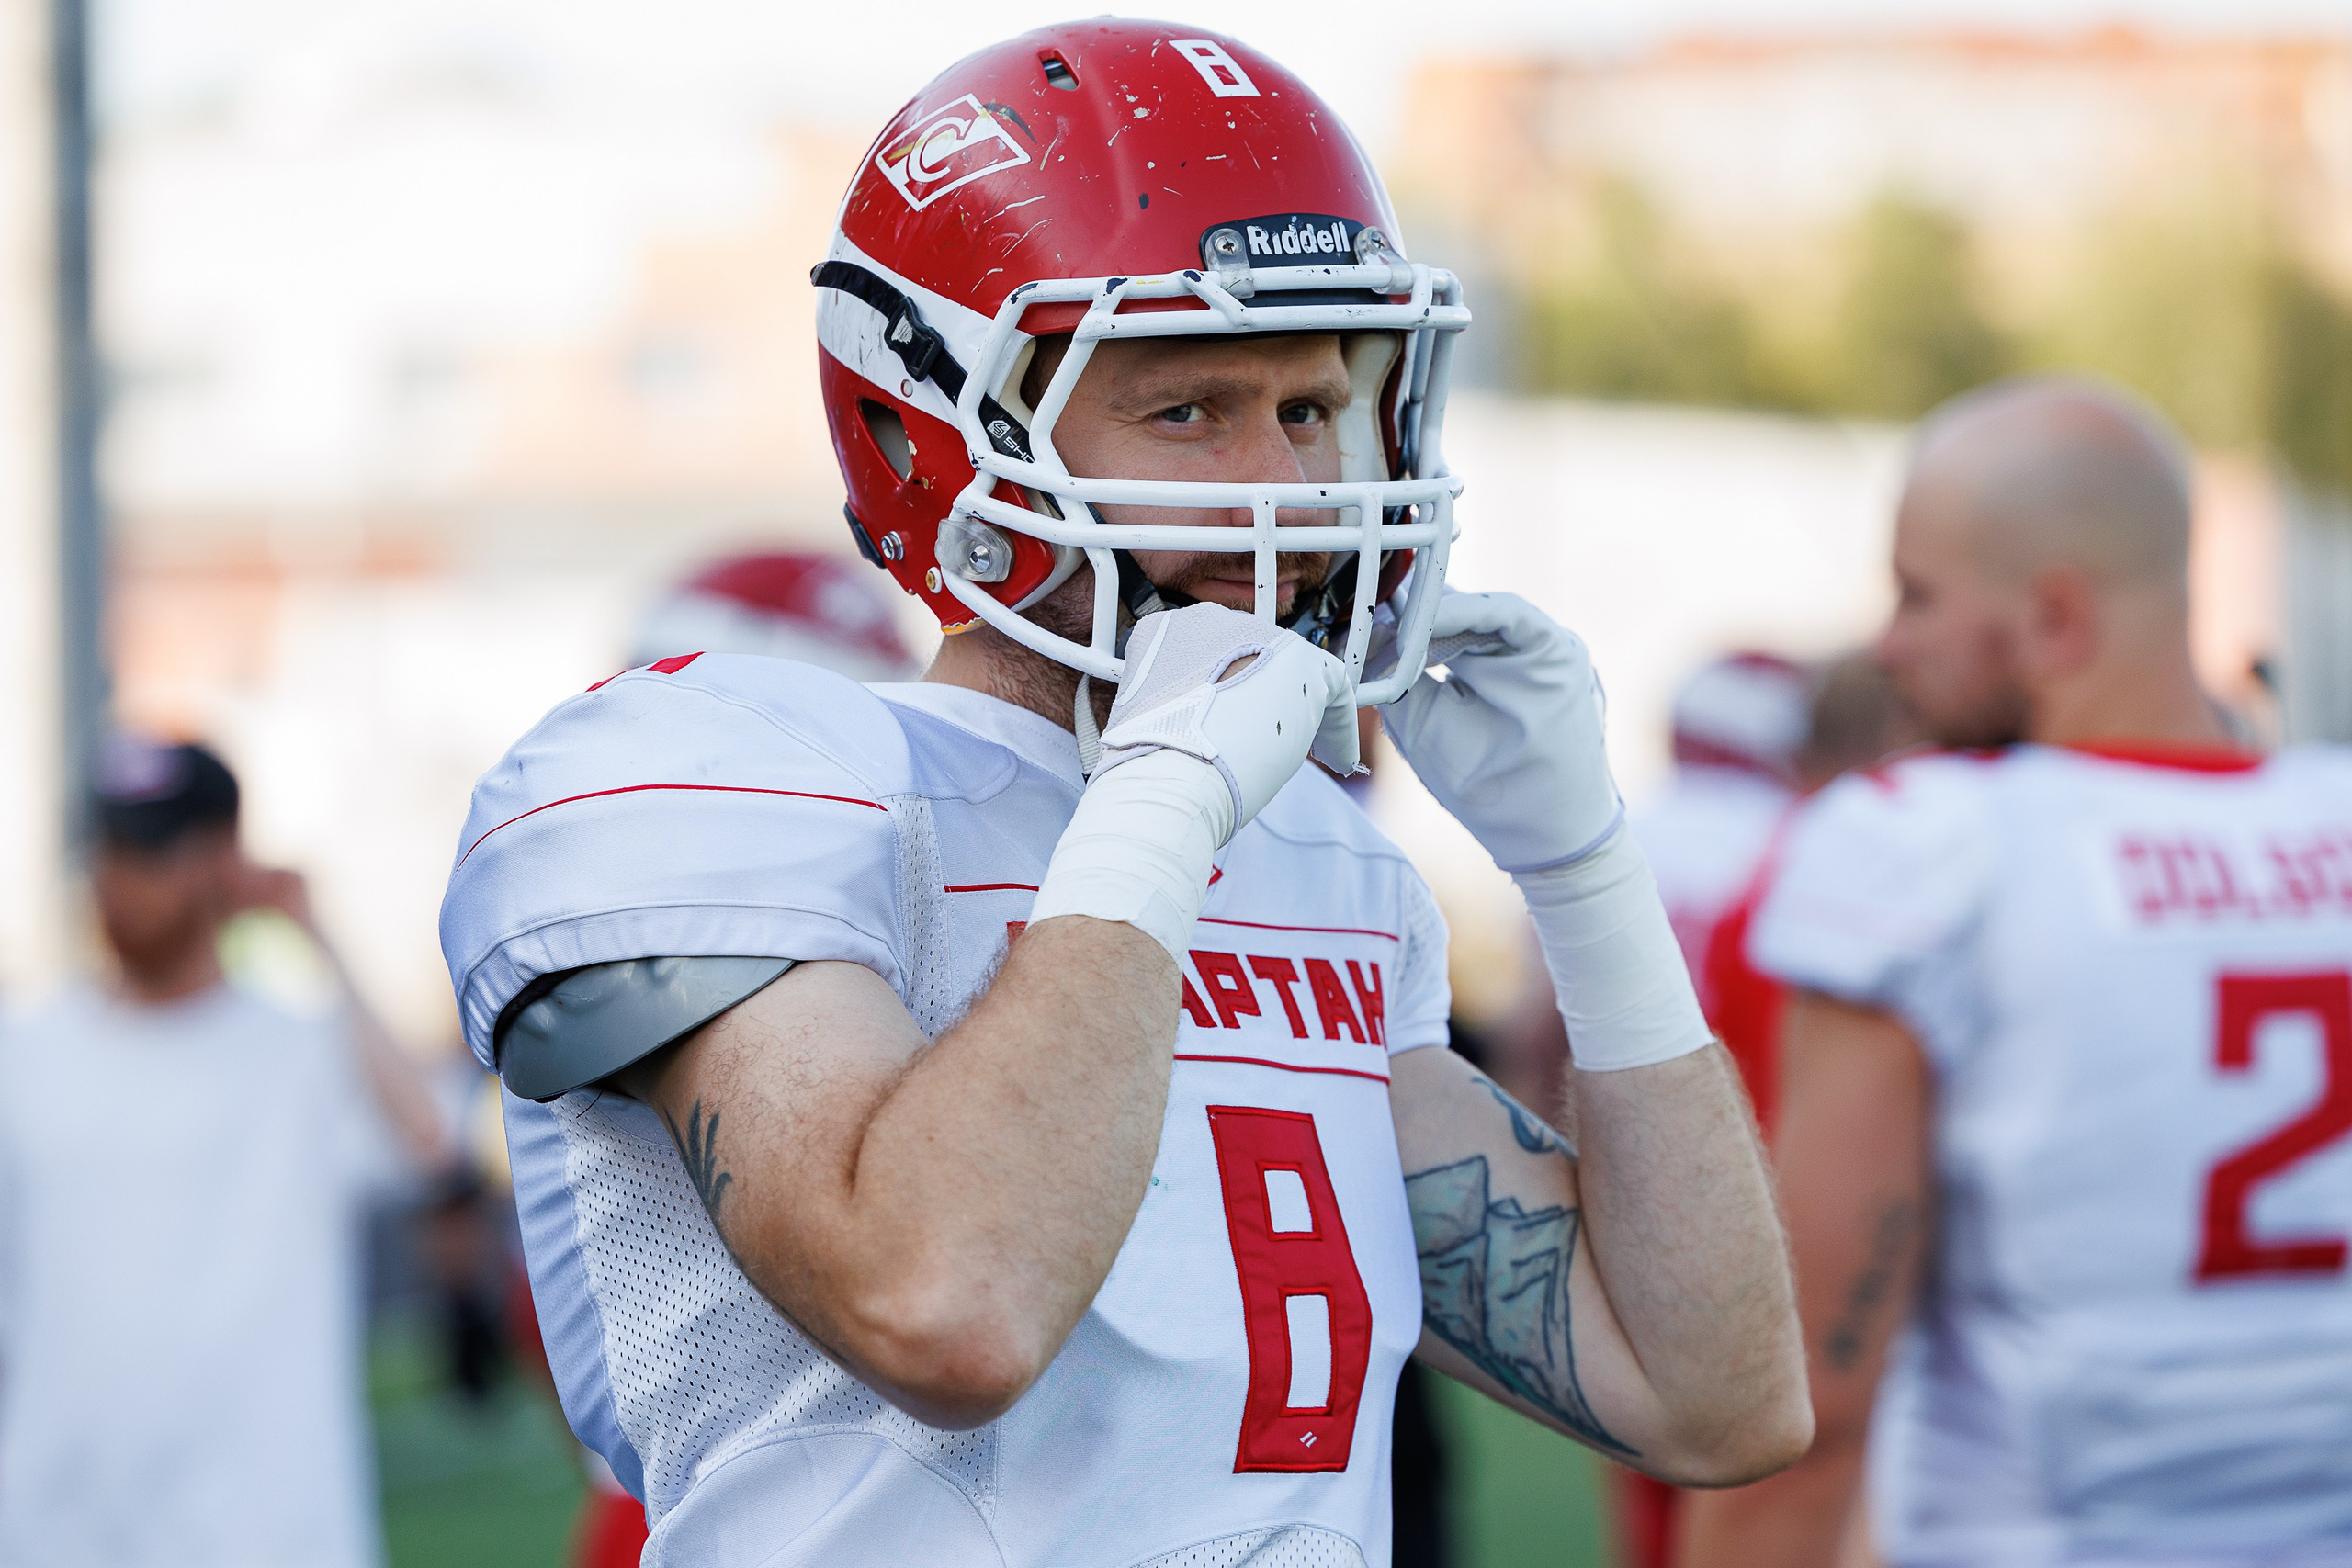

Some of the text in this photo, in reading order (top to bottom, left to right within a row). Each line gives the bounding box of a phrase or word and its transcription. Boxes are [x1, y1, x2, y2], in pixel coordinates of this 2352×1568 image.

[1170, 39, 1260, 97] 8
[1246, 216, 1351, 255] Riddell
[2194, 973, 2352, 1281] 2
[1206, 1105, 1373, 1473] 8
